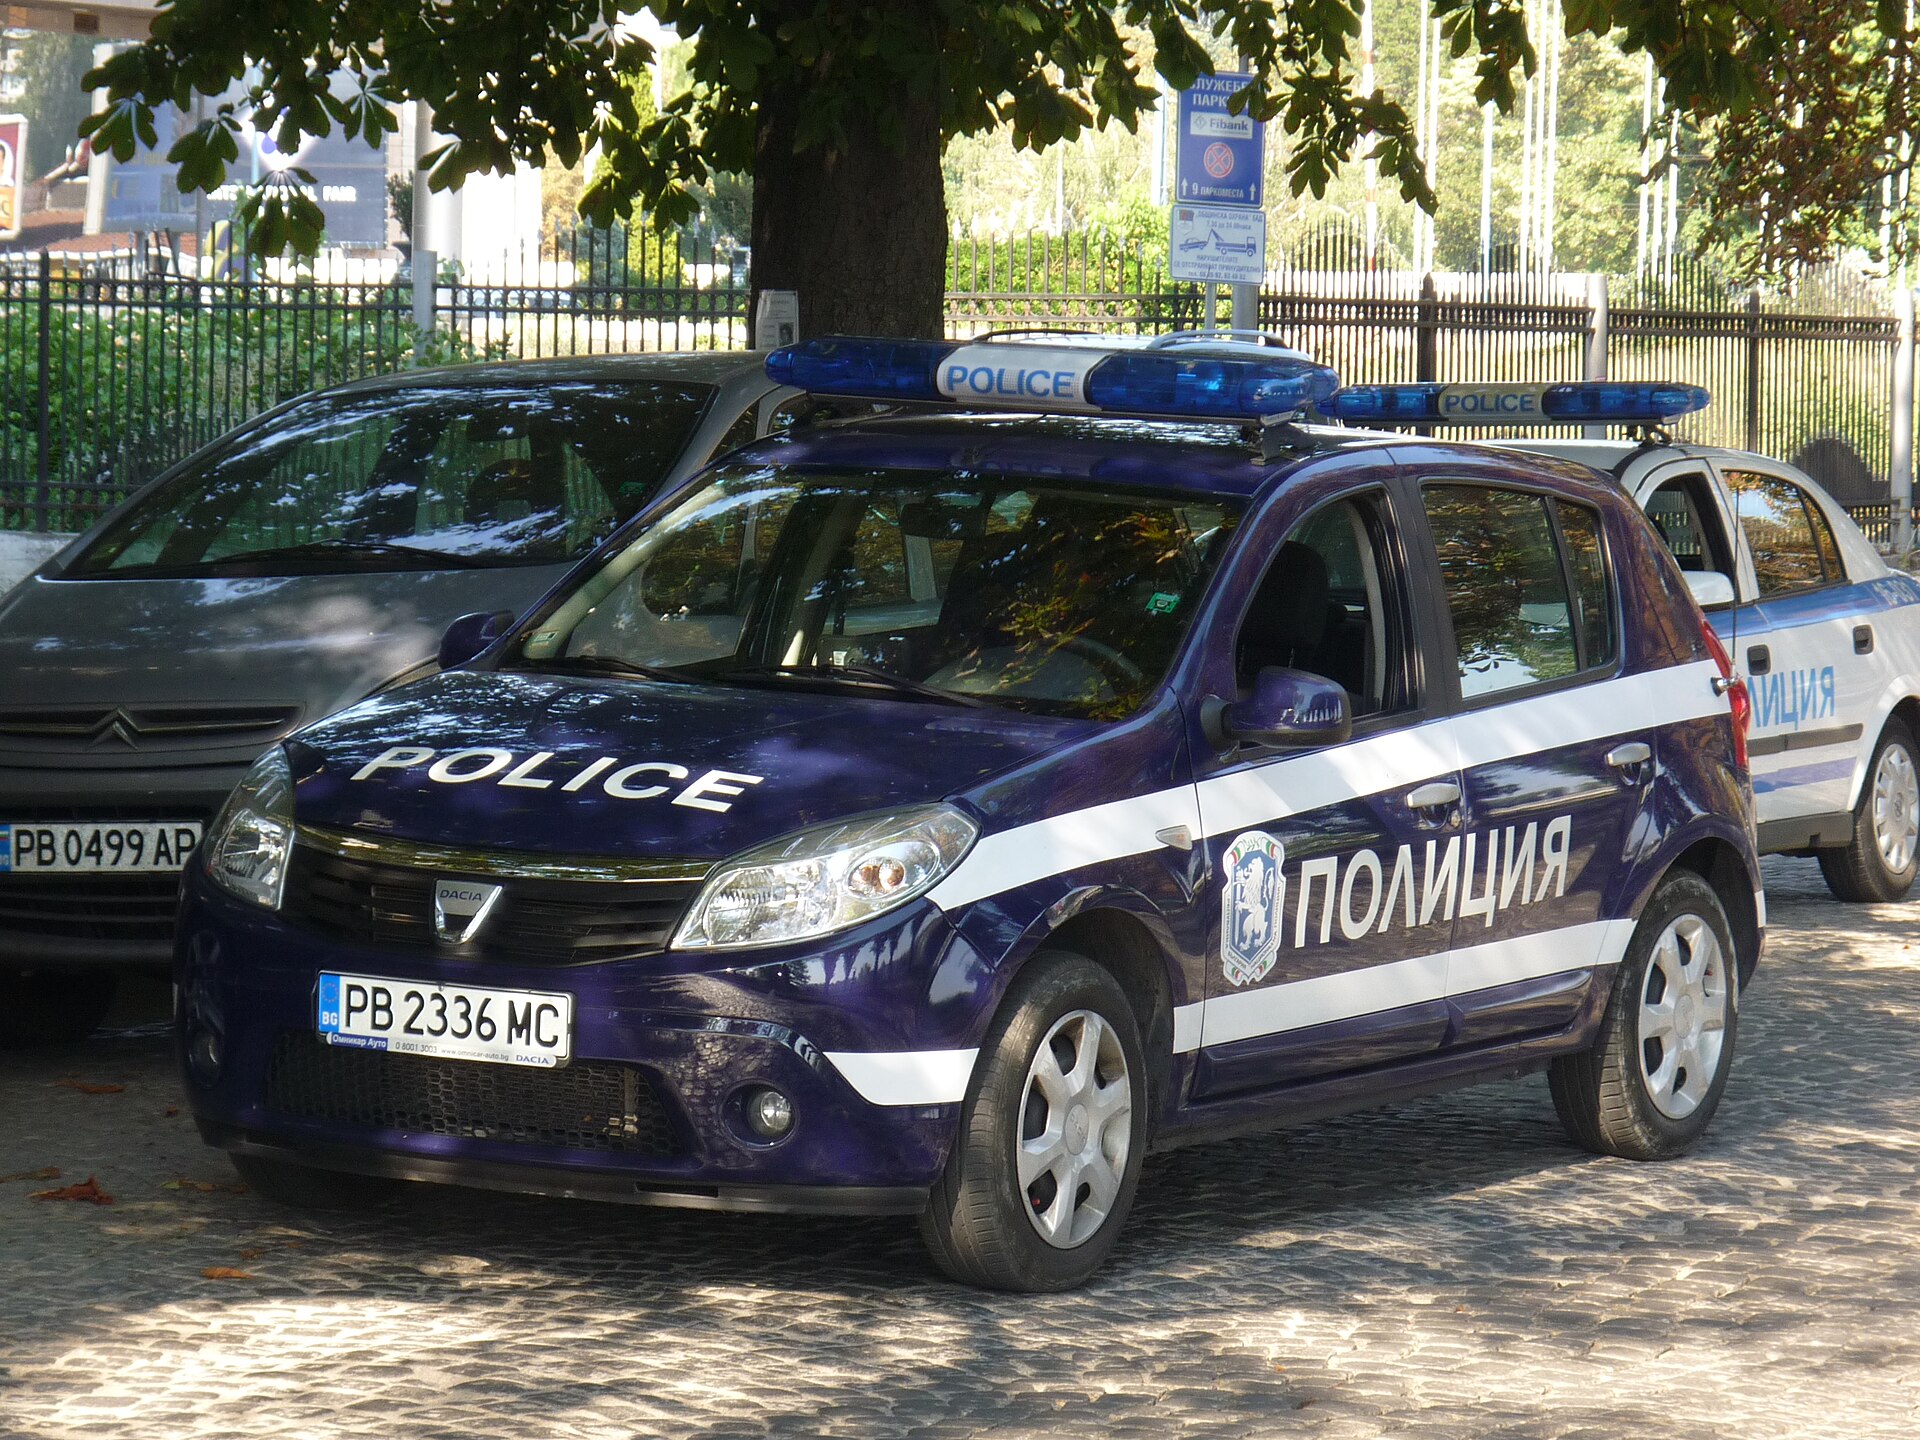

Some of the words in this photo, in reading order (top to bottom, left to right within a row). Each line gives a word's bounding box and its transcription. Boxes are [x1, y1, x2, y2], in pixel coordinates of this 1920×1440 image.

[1210, 118, 1248, 131] Fibank
[323, 185, 356, 202] FAIR
[1192, 182, 1198, 195] 9
[1200, 186, 1244, 198] ПАРКОМЕСТА
[946, 366, 1075, 398] POLICE
[1444, 393, 1535, 412] POLICE
[350, 746, 764, 813] POLICE
[65, 829, 144, 866] 0499
[1294, 815, 1572, 949] ПОЛИЦИЯ
[440, 889, 482, 901] DACIA
[322, 1011, 338, 1025] BG
[345, 984, 393, 1031] PB
[403, 990, 497, 1042] 2336
[507, 1000, 559, 1048] MC
[332, 1034, 366, 1047] Омникар
[367, 1038, 387, 1049] Ауто
[441, 1048, 509, 1062] www.omnicar-auto.bg
[515, 1054, 549, 1065] DACIA
